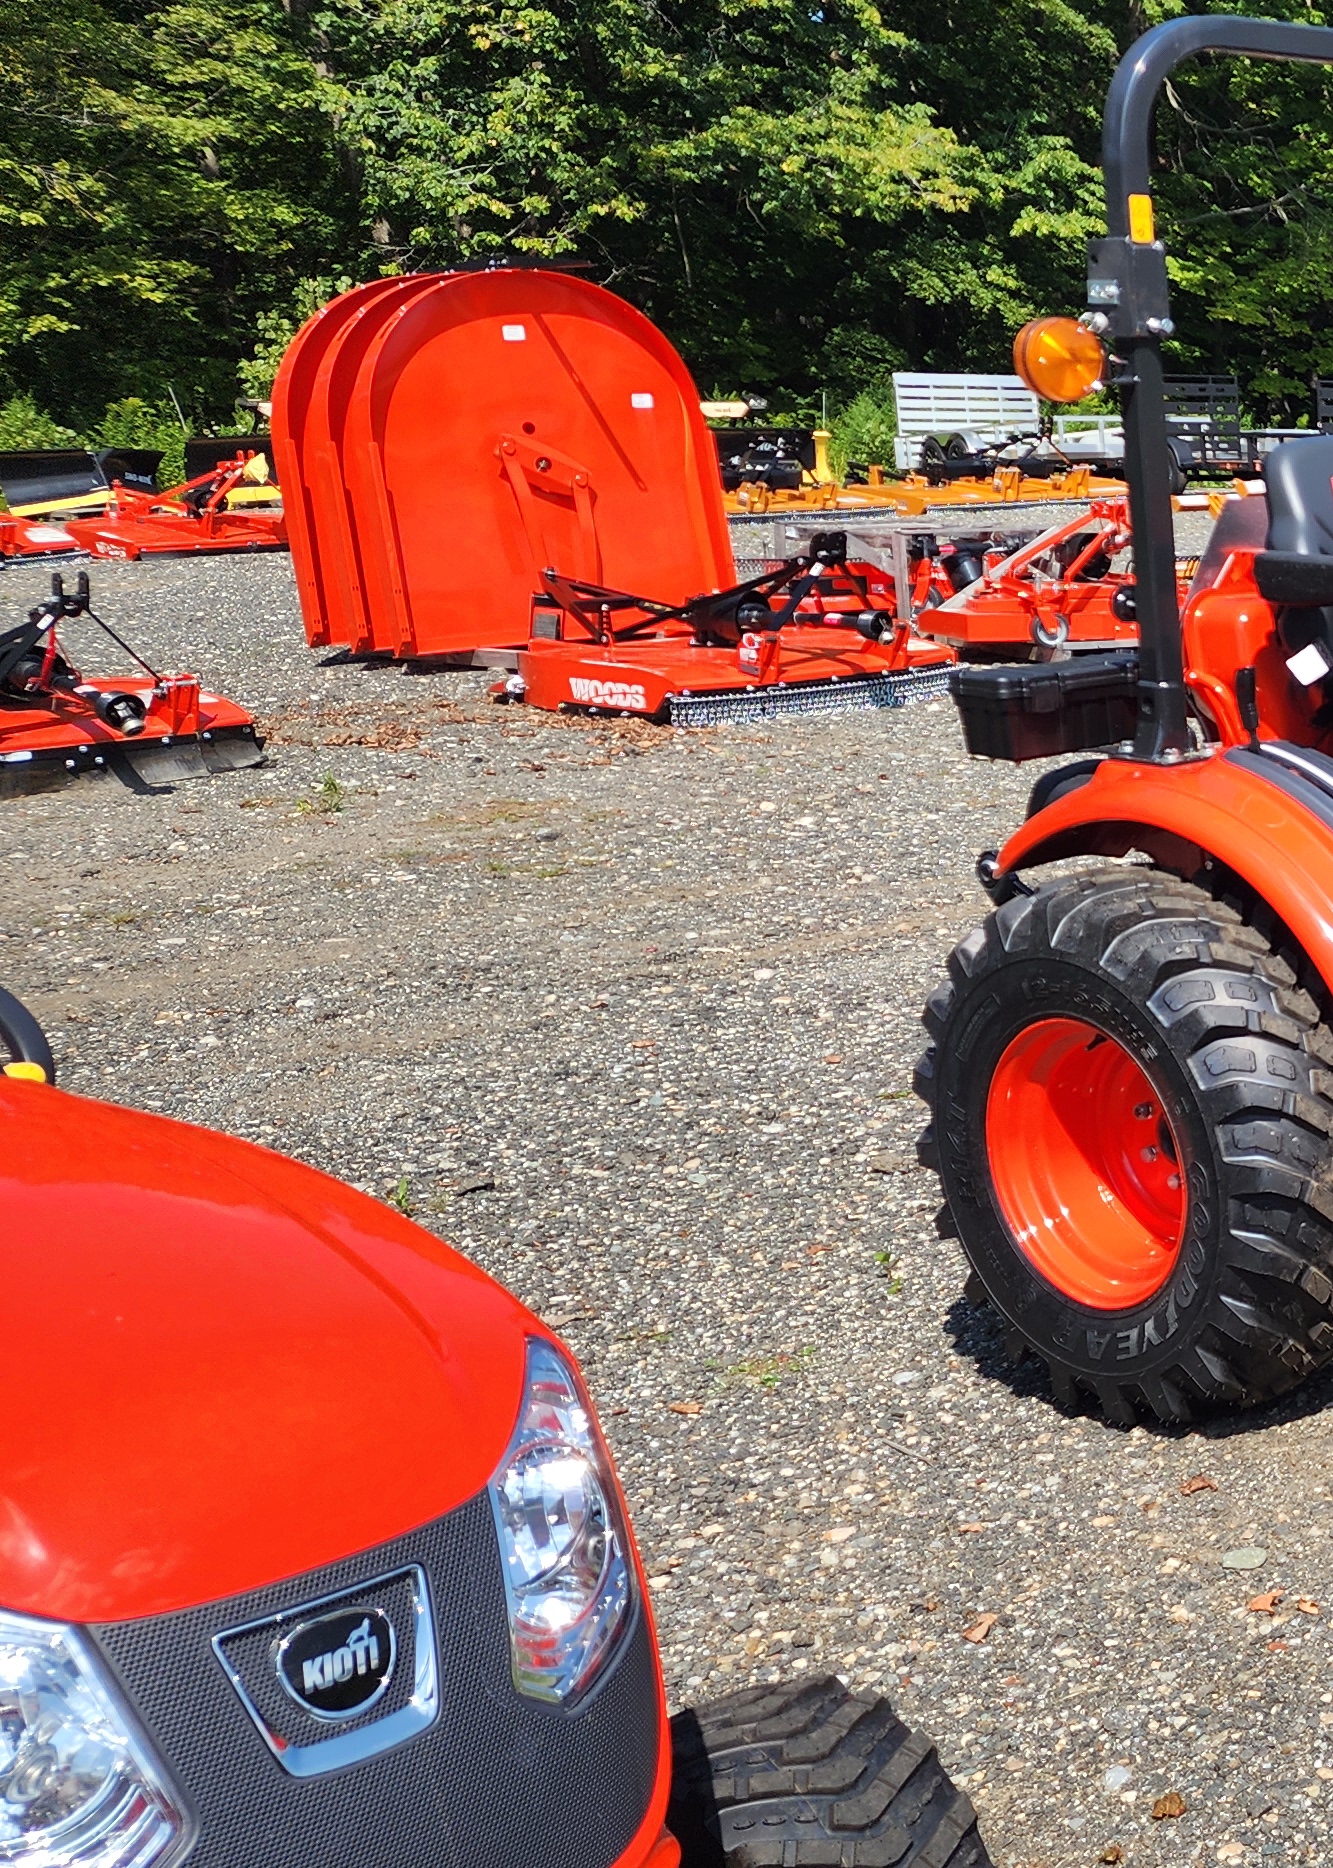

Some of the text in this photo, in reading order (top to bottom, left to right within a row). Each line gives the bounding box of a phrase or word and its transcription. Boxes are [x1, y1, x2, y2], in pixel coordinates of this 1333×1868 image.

[569, 677, 647, 709] WOODS
[1050, 1160, 1211, 1362] GOODYEAR
[303, 1635, 379, 1696] KIOTI
